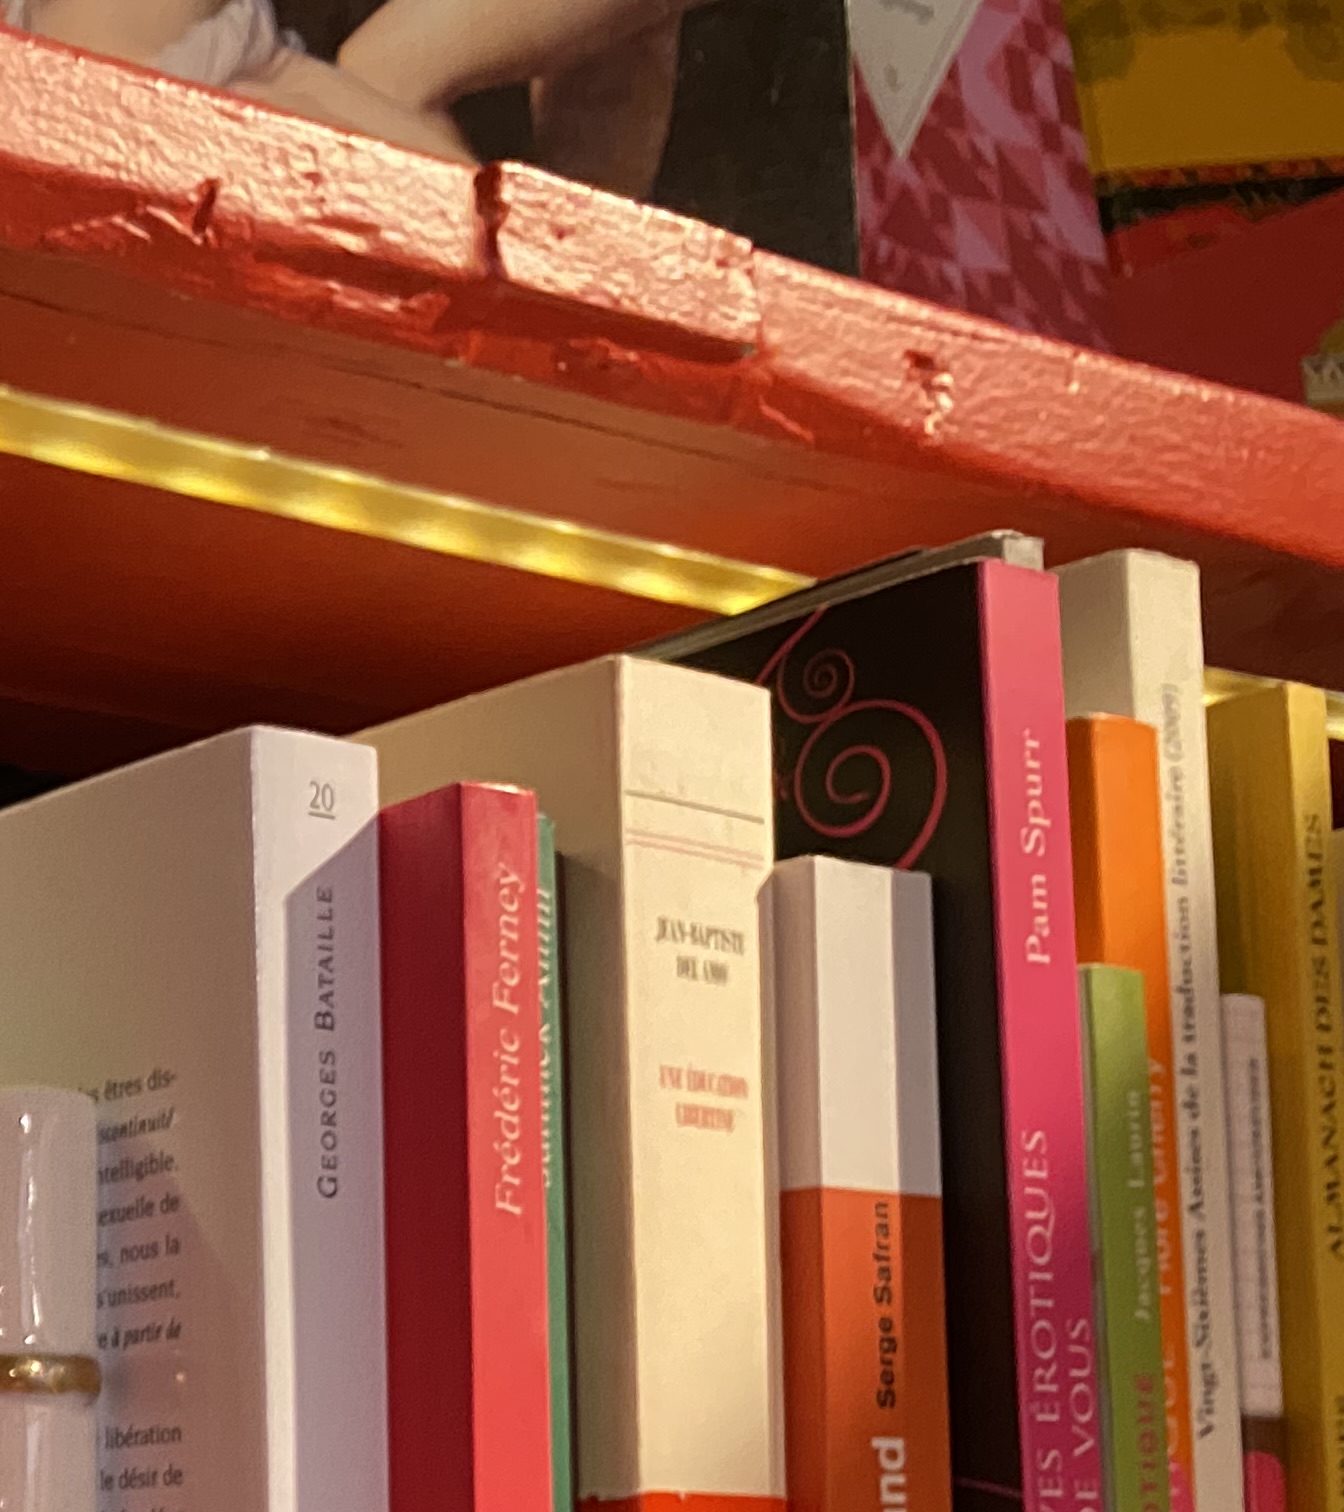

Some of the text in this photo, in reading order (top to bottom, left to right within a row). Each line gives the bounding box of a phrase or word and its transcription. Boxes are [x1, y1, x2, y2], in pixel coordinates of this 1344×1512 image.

[308, 780, 335, 812] 20
[1019, 728, 1052, 965] Pam Spurr
[491, 862, 526, 1216] Frédéric Ferney
[1171, 896, 1197, 1043] traduction
[313, 884, 340, 1201] GEORGES BATAILLE
[1180, 1053, 1198, 1078] la
[1182, 1086, 1200, 1121] de
[119, 1237, 159, 1264] nous
[872, 1201, 898, 1410] Serge Safran
[1021, 1129, 1062, 1423] ÉROTIQUES
[104, 1421, 183, 1450] libération
[1065, 1318, 1097, 1458] VOUS
[118, 1467, 158, 1491] désir
[162, 1464, 184, 1487] de
